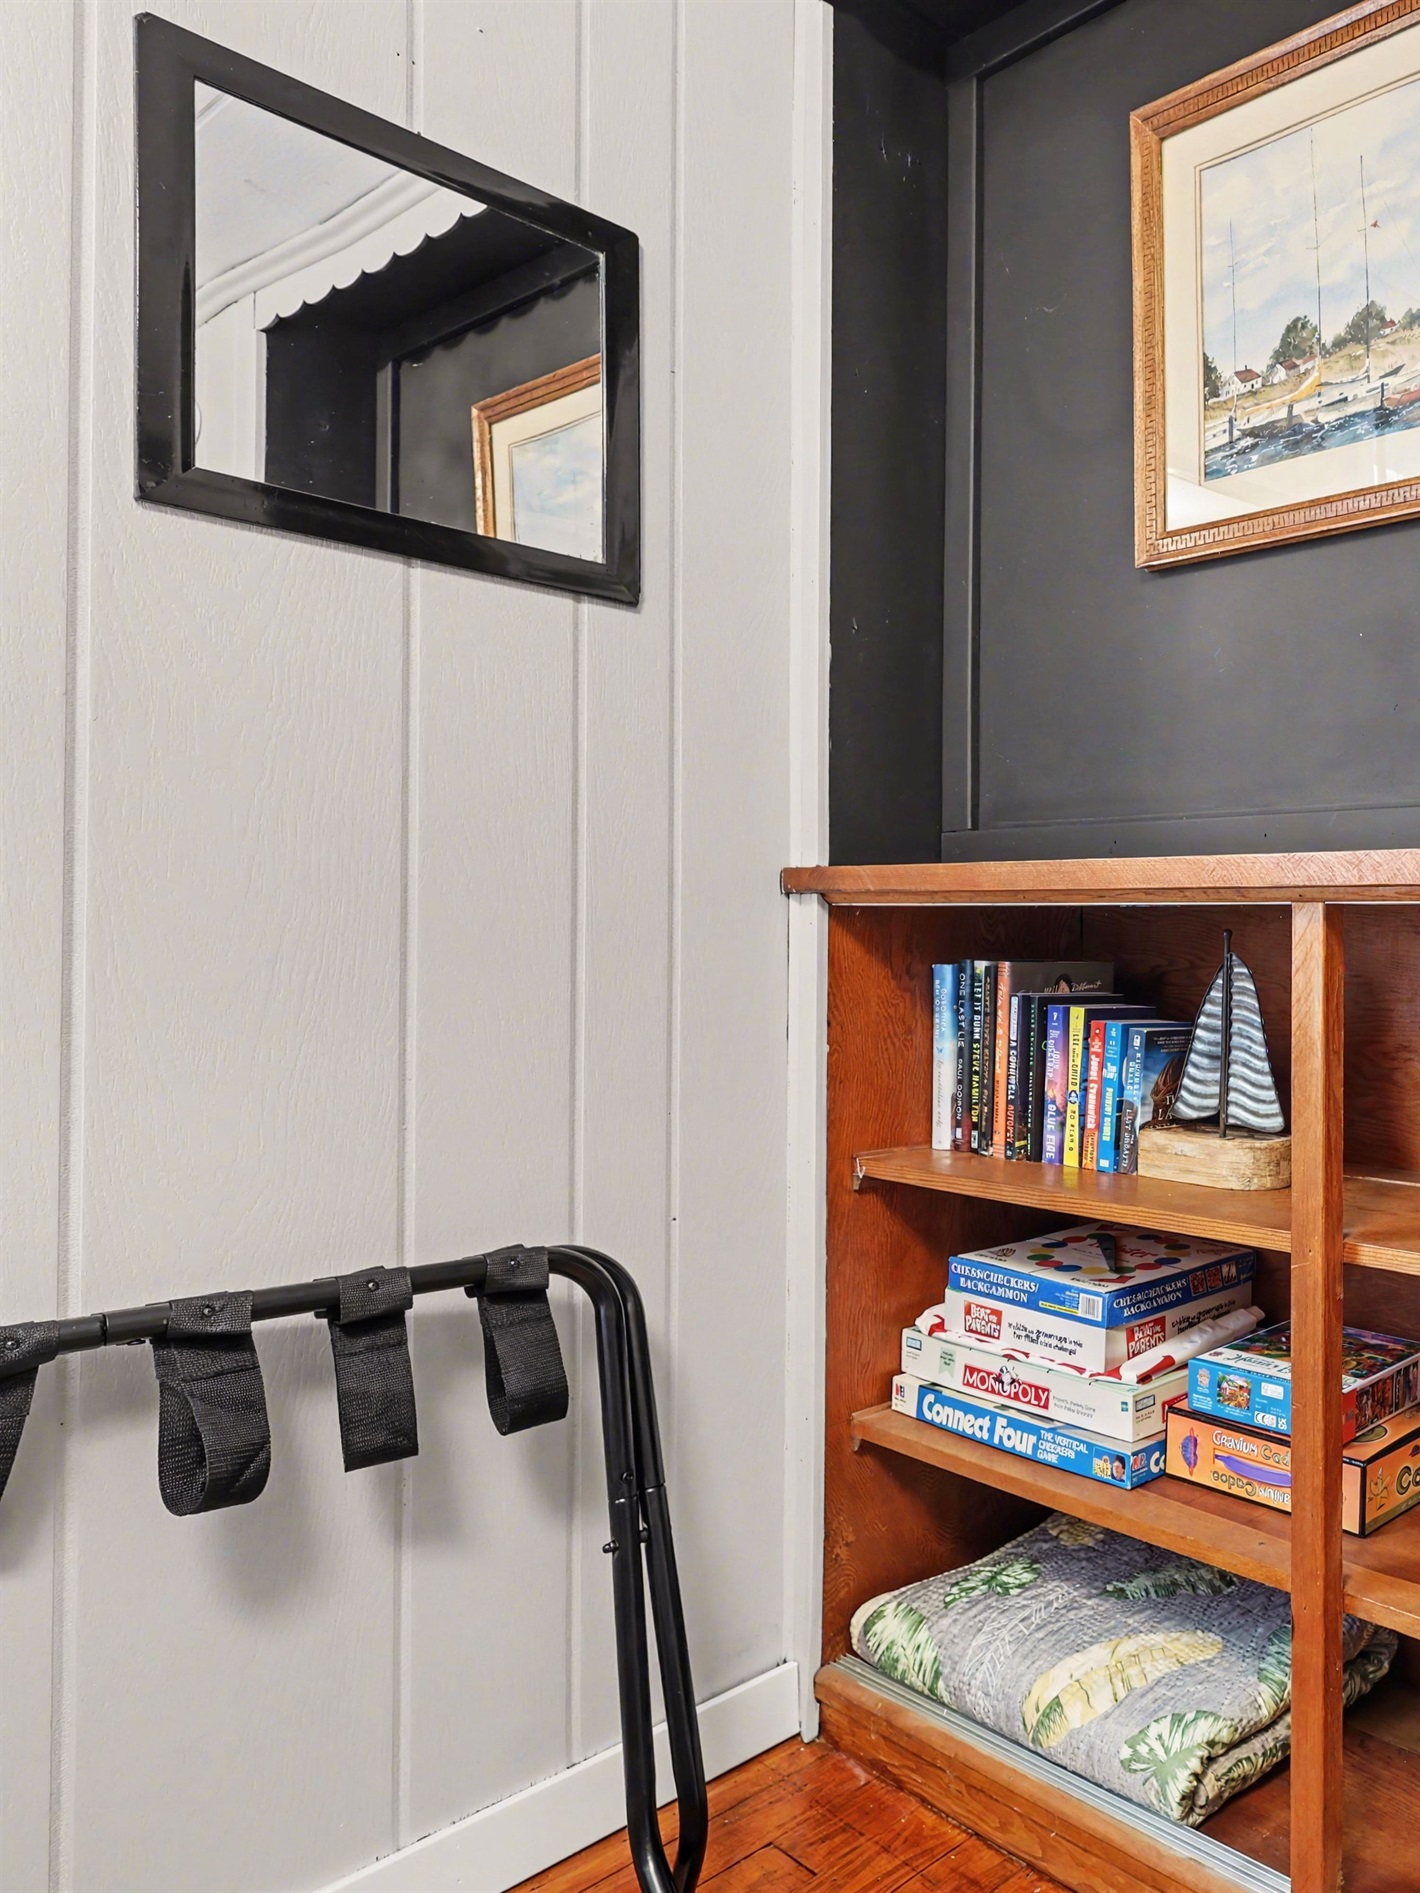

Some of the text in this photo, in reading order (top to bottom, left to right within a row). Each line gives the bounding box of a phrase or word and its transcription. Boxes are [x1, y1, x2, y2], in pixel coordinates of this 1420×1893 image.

[958, 1000, 966, 1028] LAST
[1086, 1083, 1099, 1129] Evanovich
[1046, 1103, 1057, 1160] BLUE FIRE
[959, 1277, 1028, 1304] BACKGAMMON
[970, 1303, 990, 1322] BEAT
[965, 1317, 1000, 1338] PARENTS
[963, 1367, 1049, 1406] MONOPOLY
[922, 1393, 1038, 1456] Connect Four
[1040, 1430, 1089, 1454] THE VERTICAL
[1036, 1450, 1059, 1464] GAME
